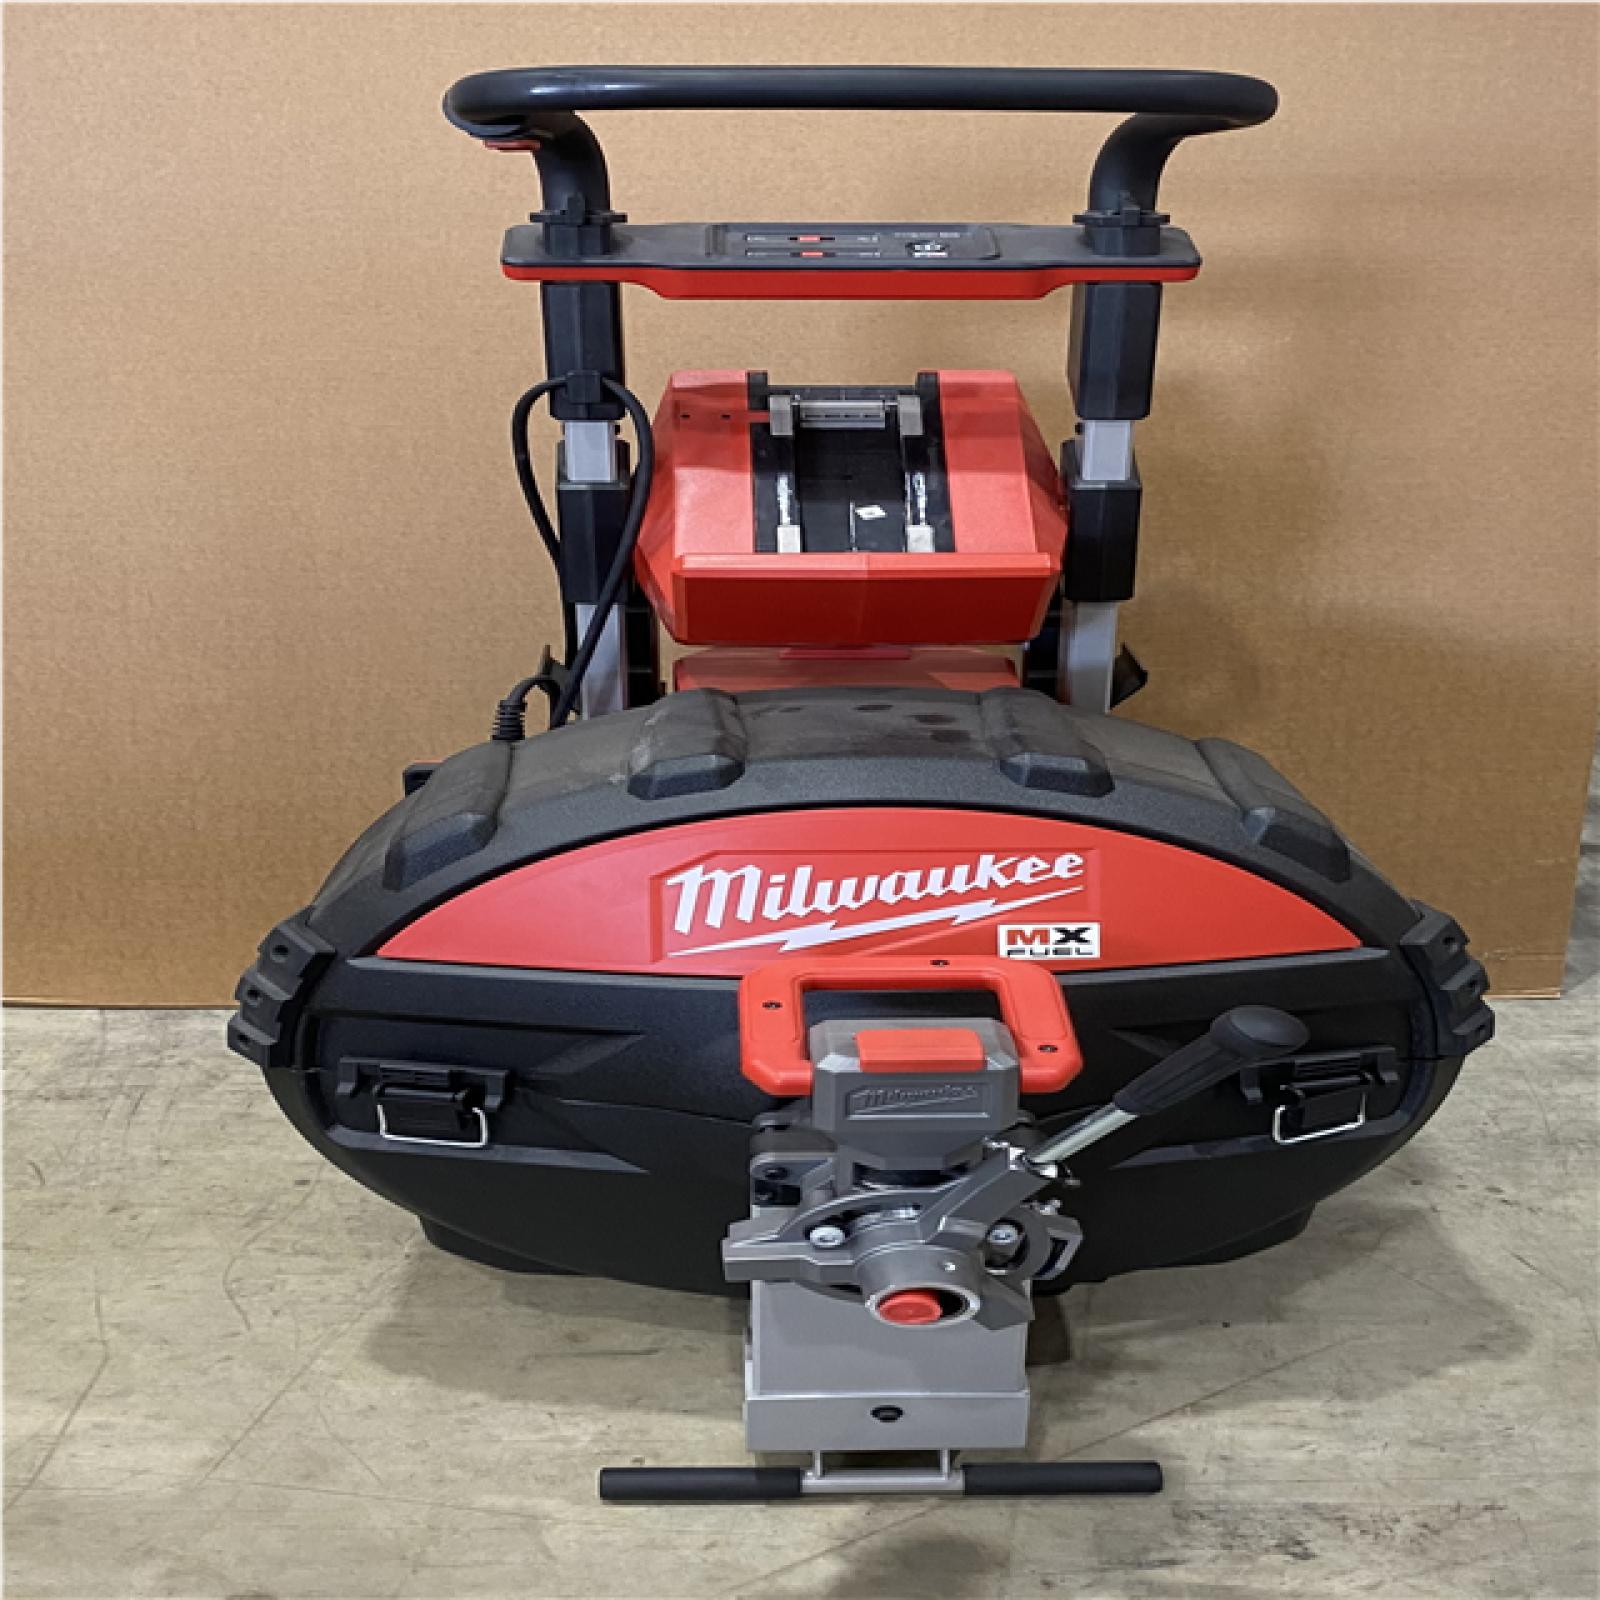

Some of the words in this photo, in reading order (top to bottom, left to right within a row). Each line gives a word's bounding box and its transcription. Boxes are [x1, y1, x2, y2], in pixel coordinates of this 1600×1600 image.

[666, 852, 1084, 935] Milwaukee
[1006, 927, 1091, 945] MX
[1006, 947, 1093, 957] FUEL
